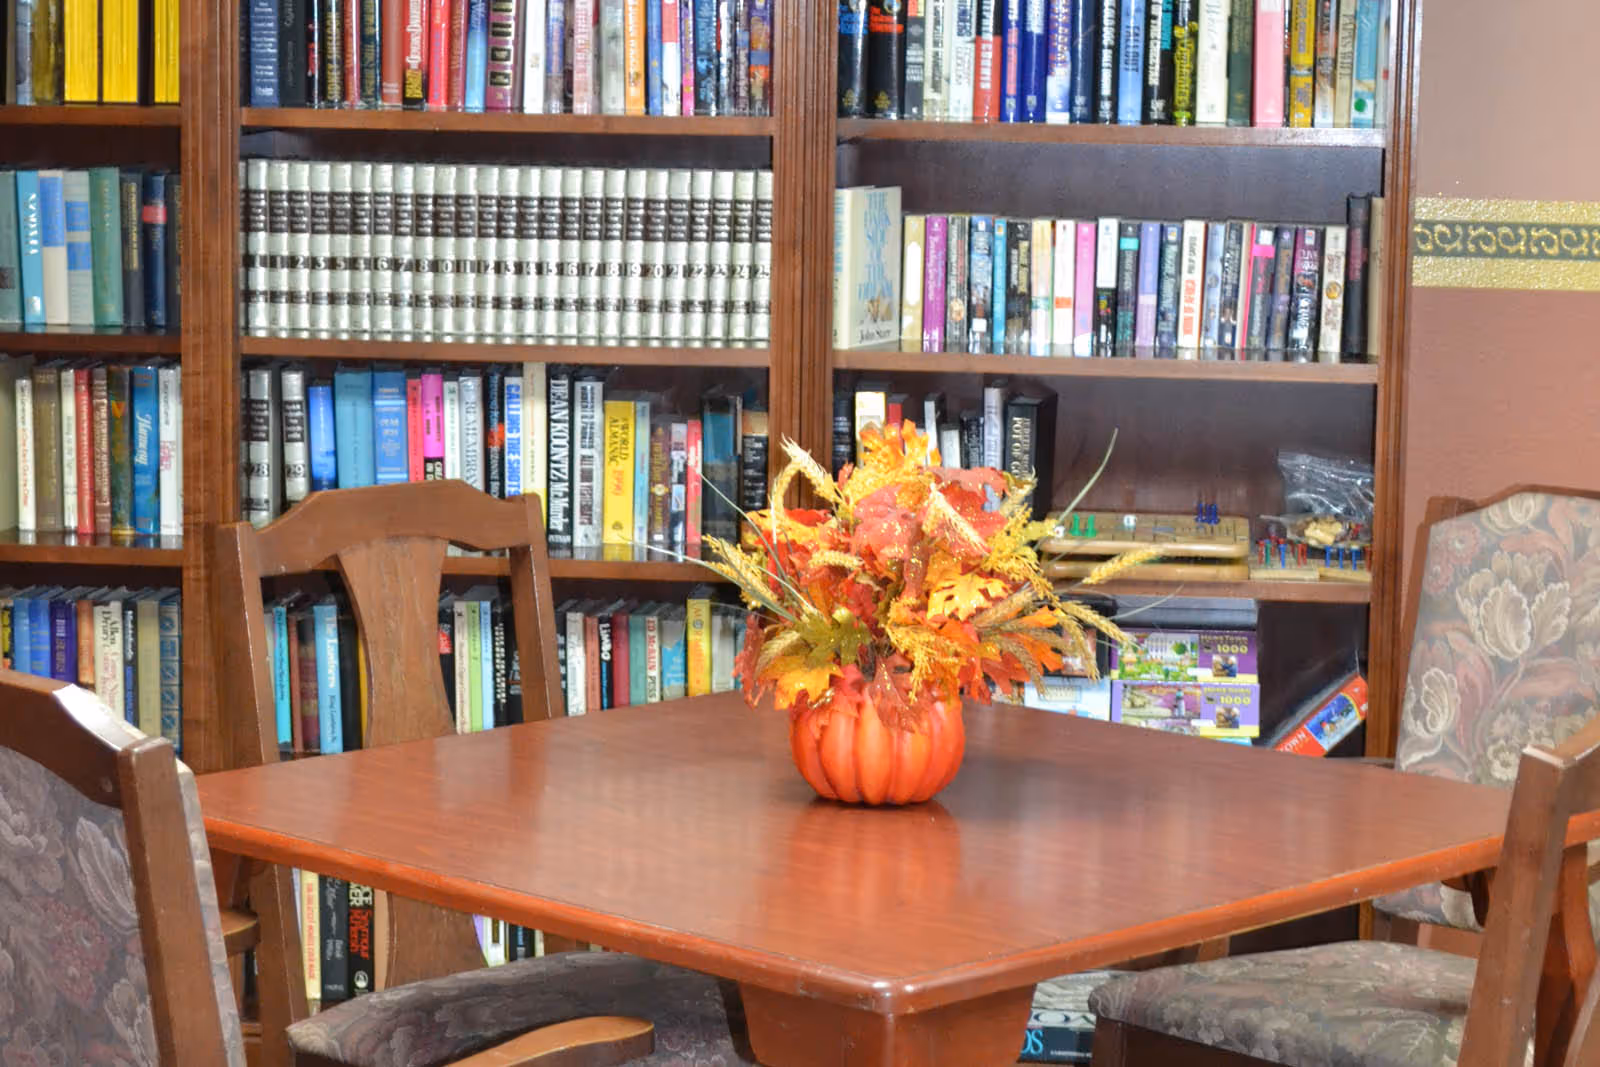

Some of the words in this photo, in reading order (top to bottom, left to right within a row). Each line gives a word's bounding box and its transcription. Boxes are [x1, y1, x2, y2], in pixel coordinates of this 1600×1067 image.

[295, 258, 304, 268] 2
[316, 258, 324, 269] 3
[377, 258, 387, 270] 6
[398, 258, 407, 270] 7
[419, 259, 428, 271] 8
[506, 384, 520, 434] CALLING
[550, 379, 569, 420] DEAN
[136, 412, 152, 465] Harmony
[1012, 416, 1022, 440] POT
[507, 437, 520, 454] THE
[550, 422, 569, 480] KOONTZ
[608, 416, 618, 466] ALMANAC
[620, 422, 629, 460] WORLD
[1012, 443, 1022, 458] OF
[507, 458, 520, 496] SHOTS
[550, 498, 568, 532] Murder
[110, 619, 120, 645] Allen
[1217, 644, 1248, 654] 1000
[648, 675, 656, 699] PUSS
[1220, 696, 1251, 704] 1000
